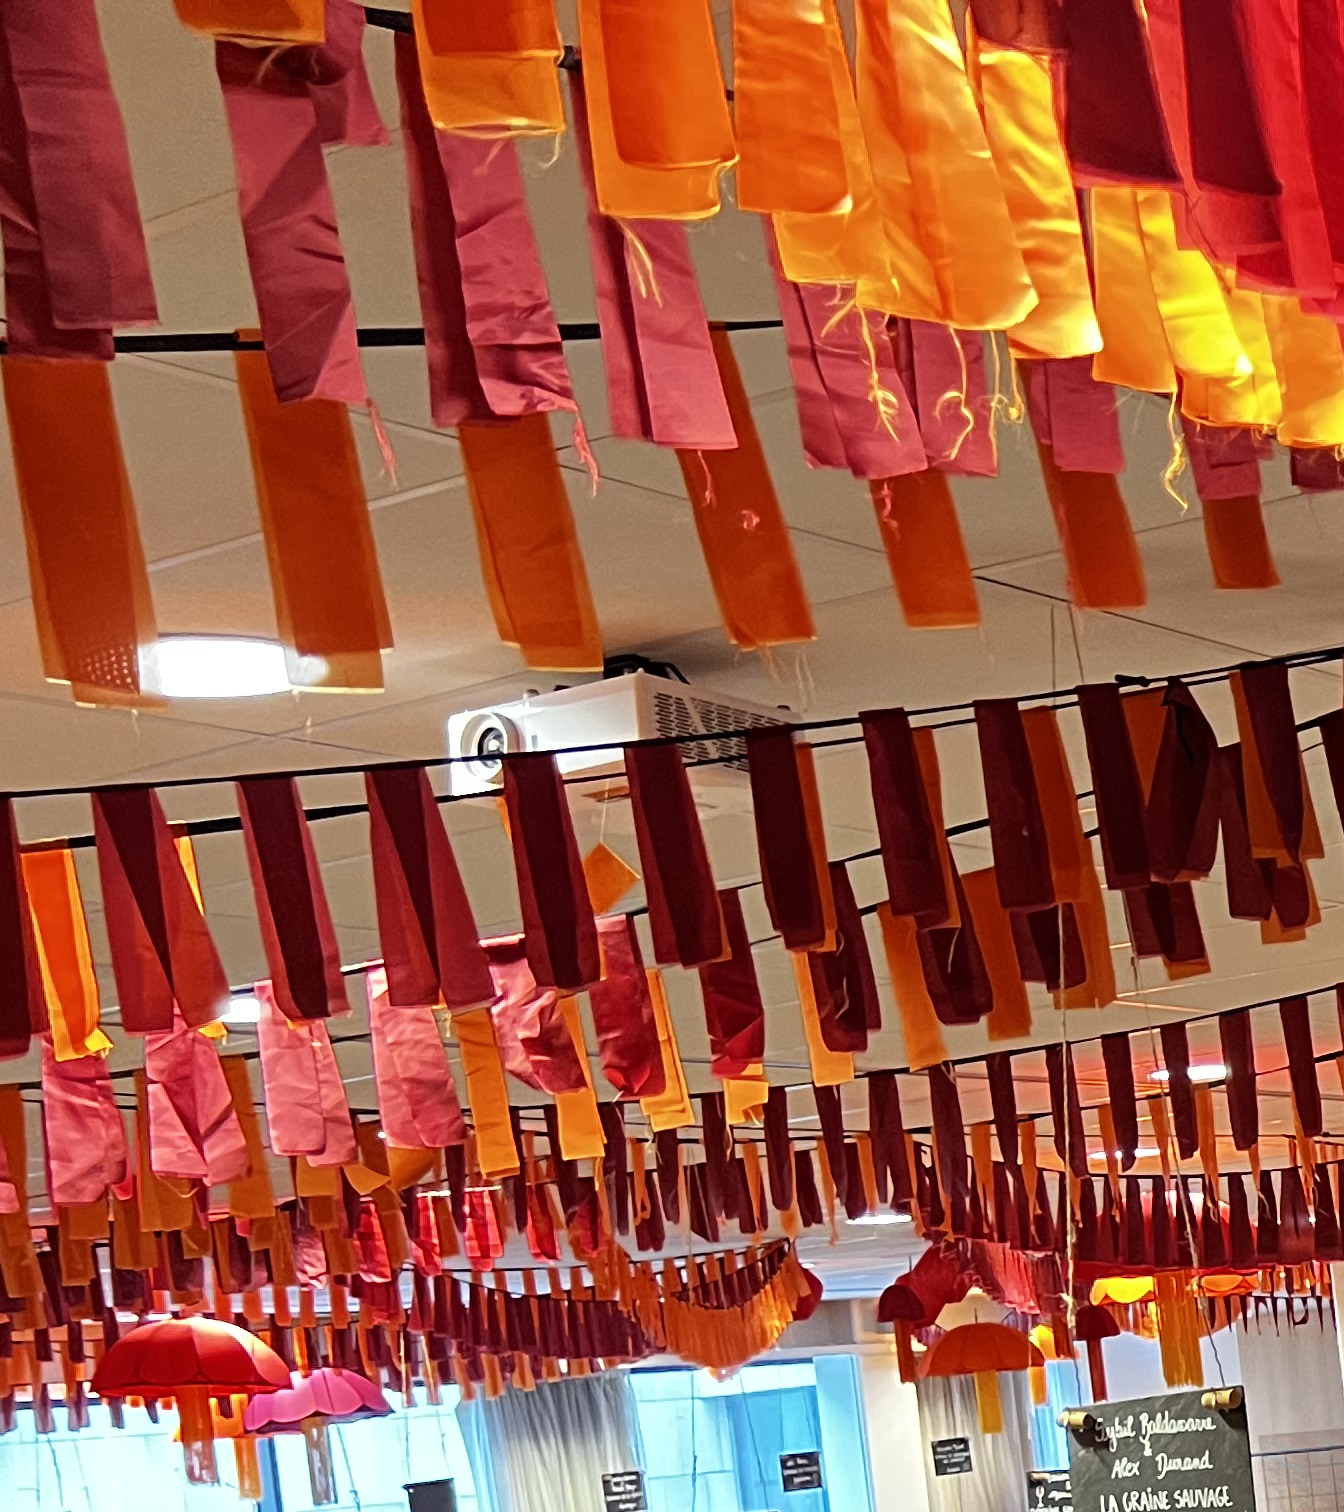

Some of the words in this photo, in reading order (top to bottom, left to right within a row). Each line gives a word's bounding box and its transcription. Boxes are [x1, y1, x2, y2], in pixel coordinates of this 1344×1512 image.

[1111, 1457, 1140, 1480] Alex
[1155, 1450, 1214, 1480] Durand
[1174, 1485, 1234, 1509] SAUVAGE
